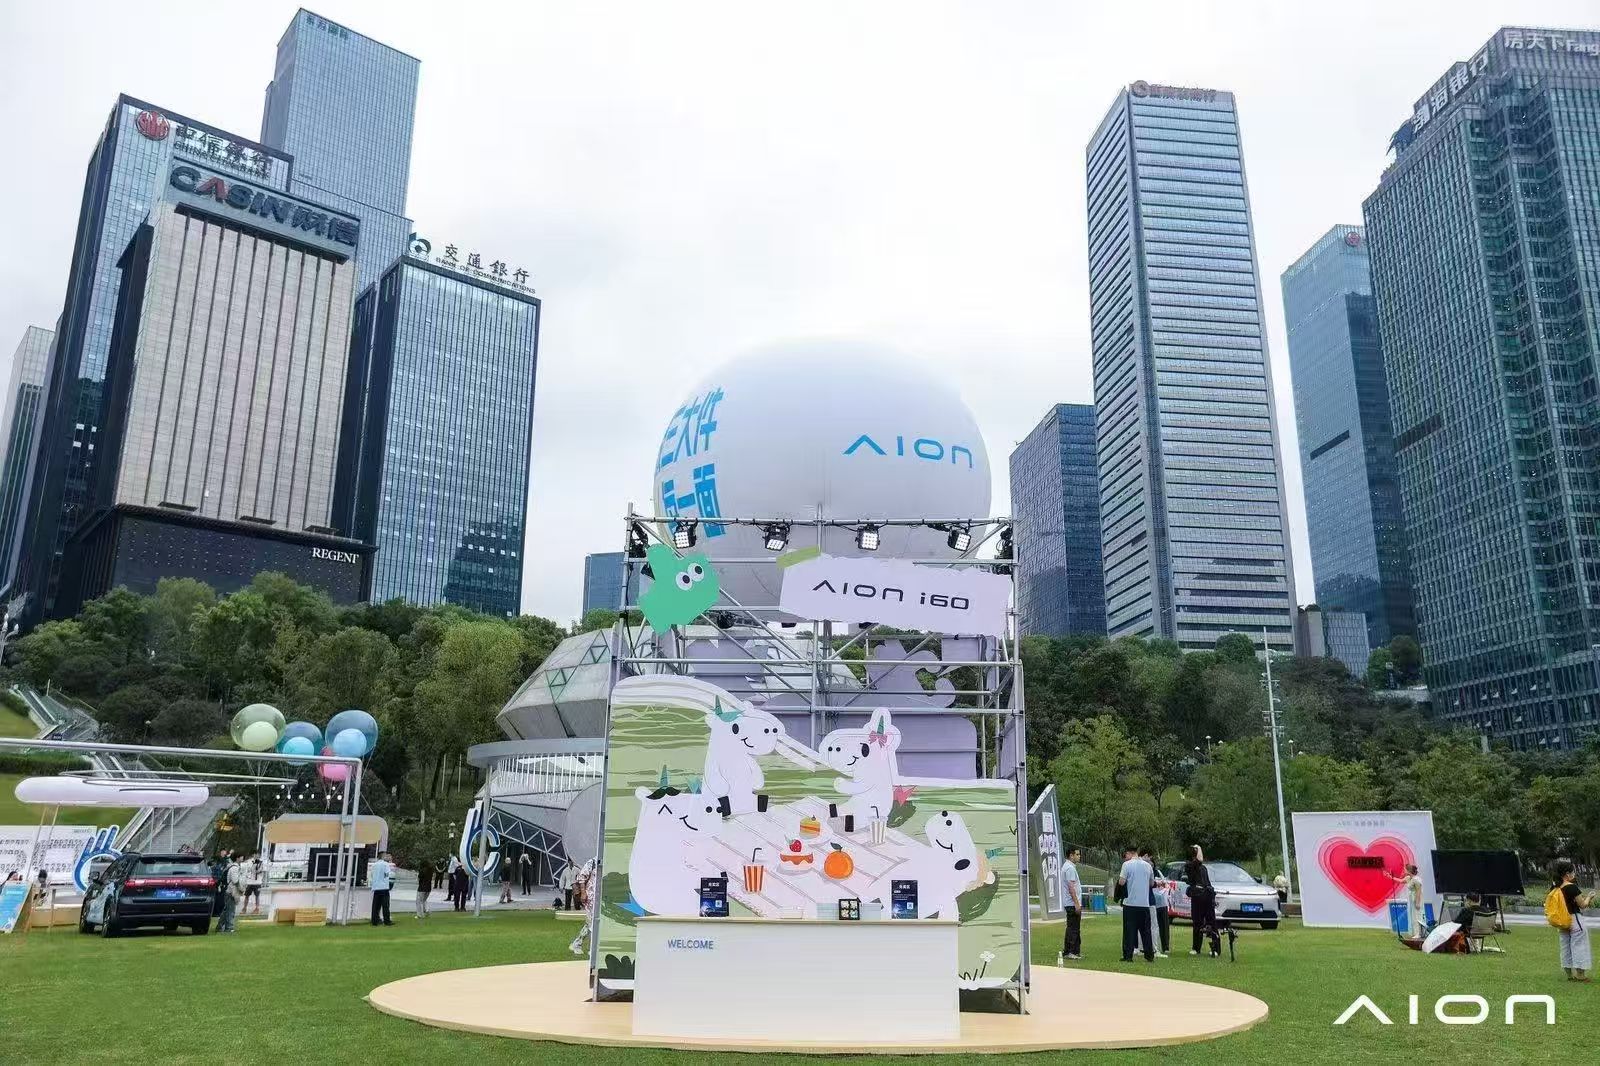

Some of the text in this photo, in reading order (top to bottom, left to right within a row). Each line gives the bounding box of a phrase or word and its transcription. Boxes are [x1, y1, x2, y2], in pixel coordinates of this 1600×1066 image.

[1503, 29, 1564, 50] 房天下
[170, 166, 292, 224] CASIN
[460, 265, 469, 273] OF
[312, 547, 360, 564] REGENT
[920, 592, 969, 610] i60
[667, 938, 714, 950] WELCOME
